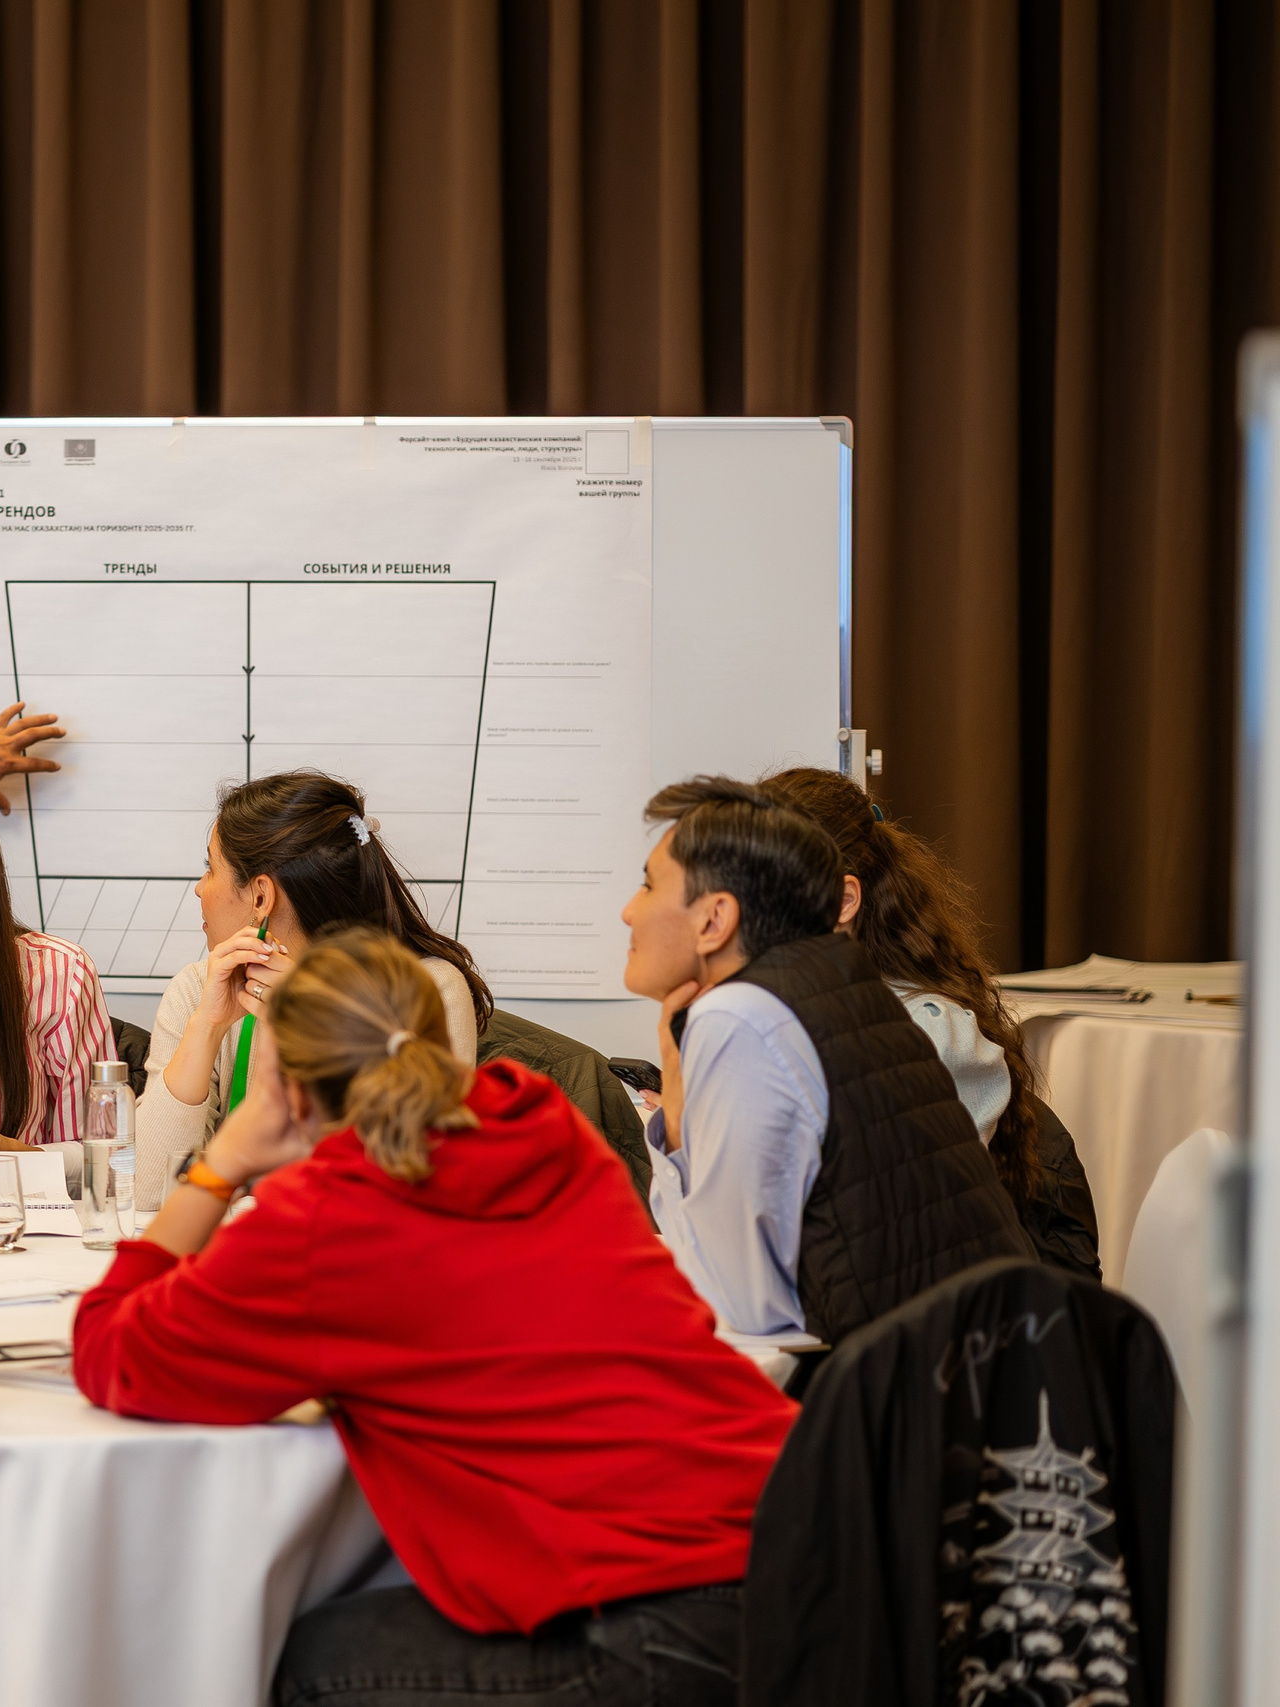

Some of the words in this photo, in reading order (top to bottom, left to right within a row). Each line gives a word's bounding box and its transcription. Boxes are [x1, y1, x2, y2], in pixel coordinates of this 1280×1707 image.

[31, 525, 82, 533] (КАЗАХСТАН)
[103, 563, 157, 576] ТРЕНДЫ
[303, 563, 368, 574] СОБЫТИЯ
[372, 563, 382, 574] И
[385, 563, 451, 574] РЕШЕНИЯ
